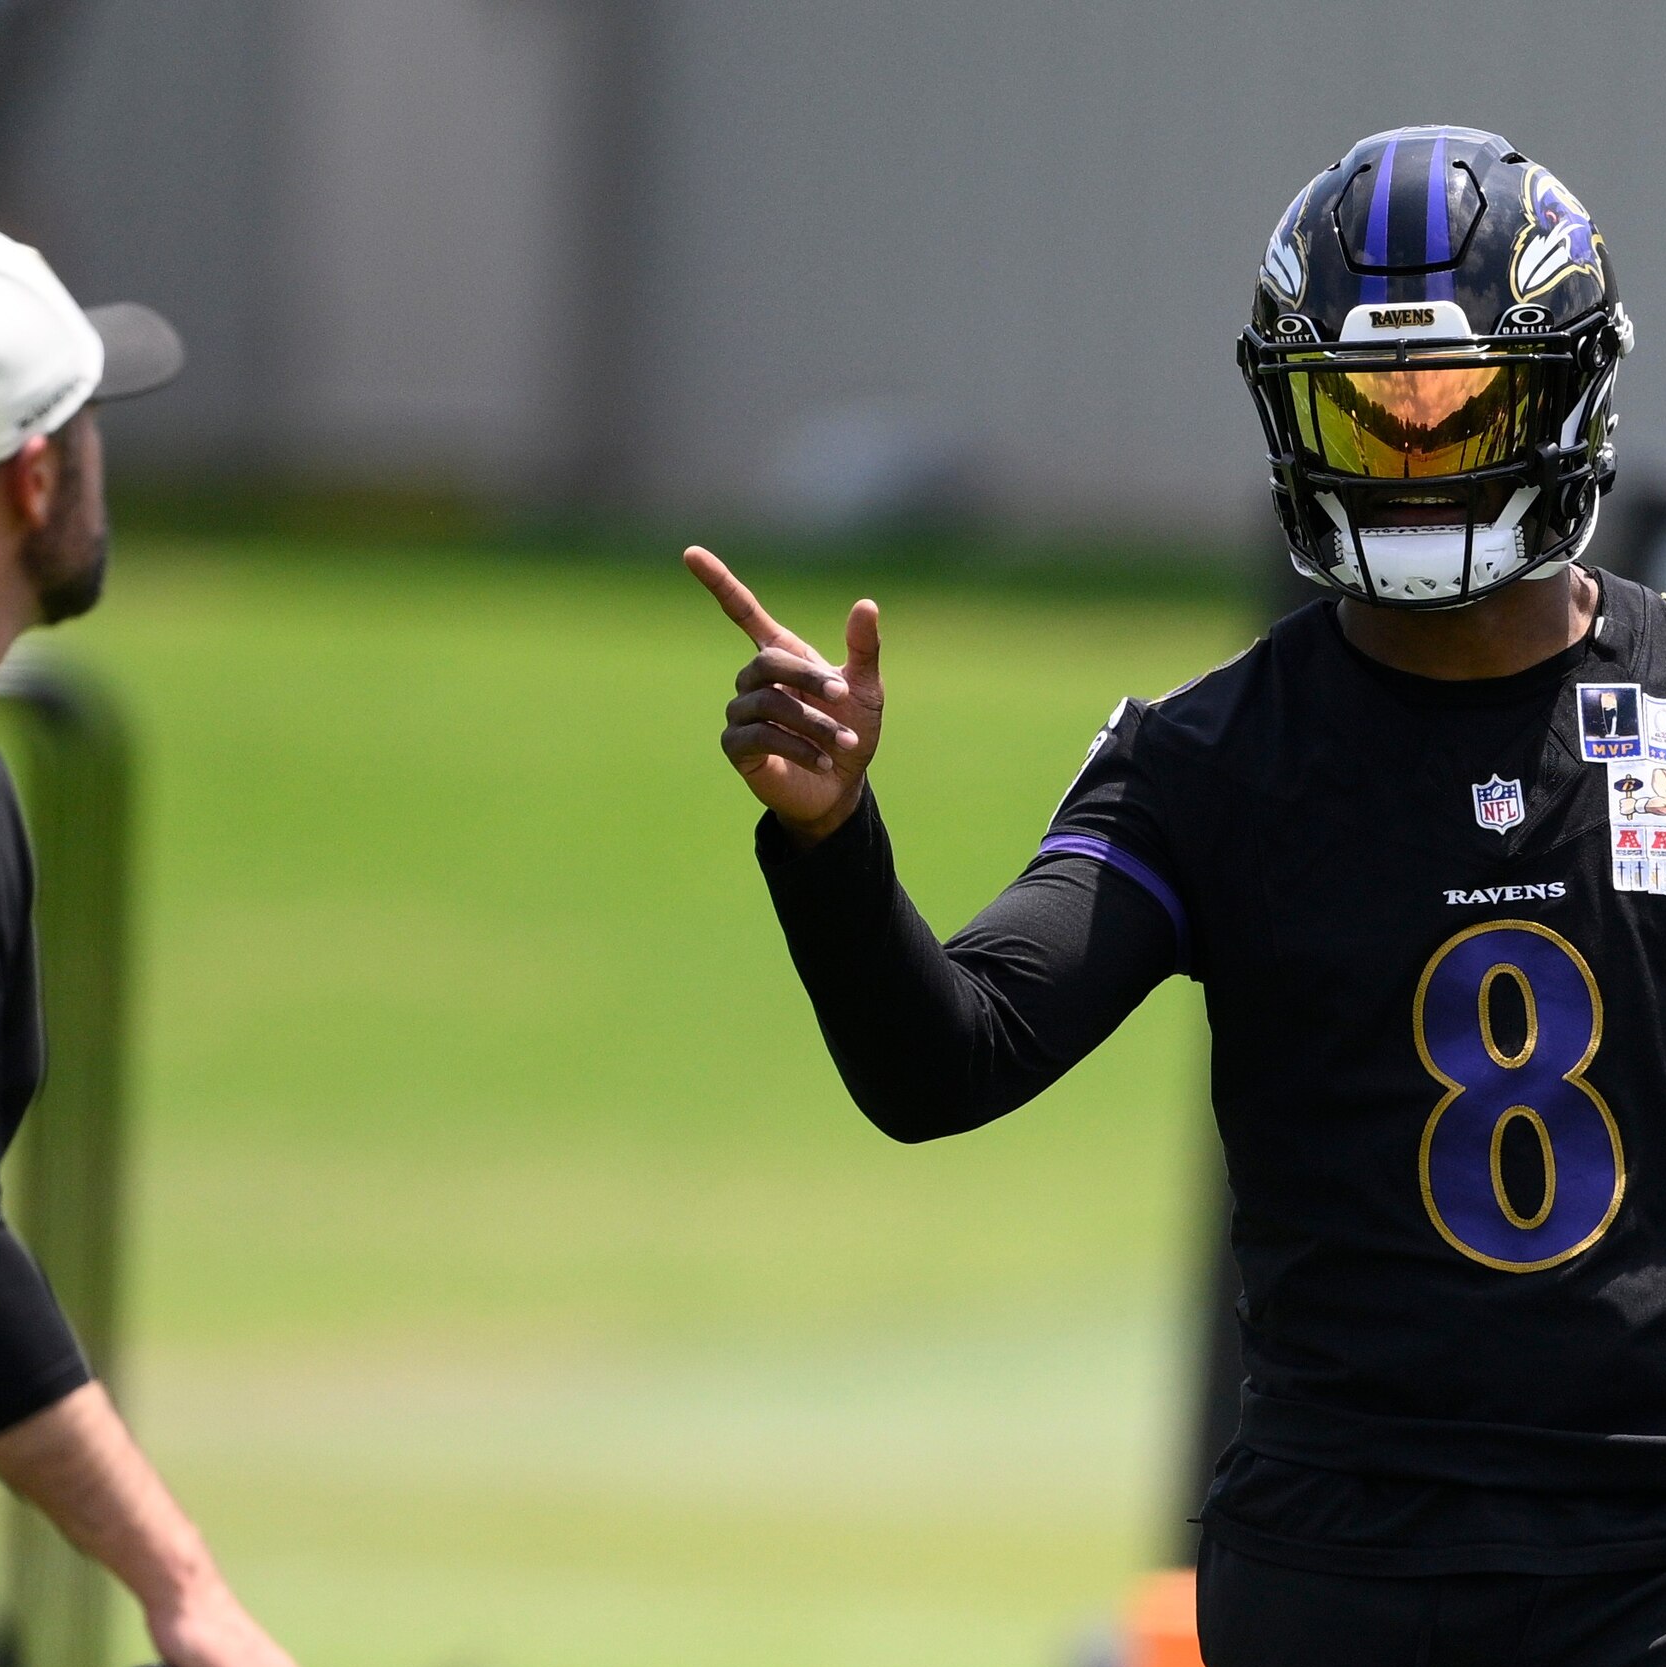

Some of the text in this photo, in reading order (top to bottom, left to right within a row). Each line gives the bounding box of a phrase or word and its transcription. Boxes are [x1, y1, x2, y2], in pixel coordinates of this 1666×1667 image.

[1369, 308, 1434, 329] RAVENS
[1274, 333, 1313, 344] OAKLEY
[1502, 324, 1554, 335] OAKLEY
[1592, 742, 1634, 756] MVP
[1481, 799, 1518, 823] NFL
[1442, 881, 1567, 905] RAVENS
[1413, 918, 1626, 1274] 8
